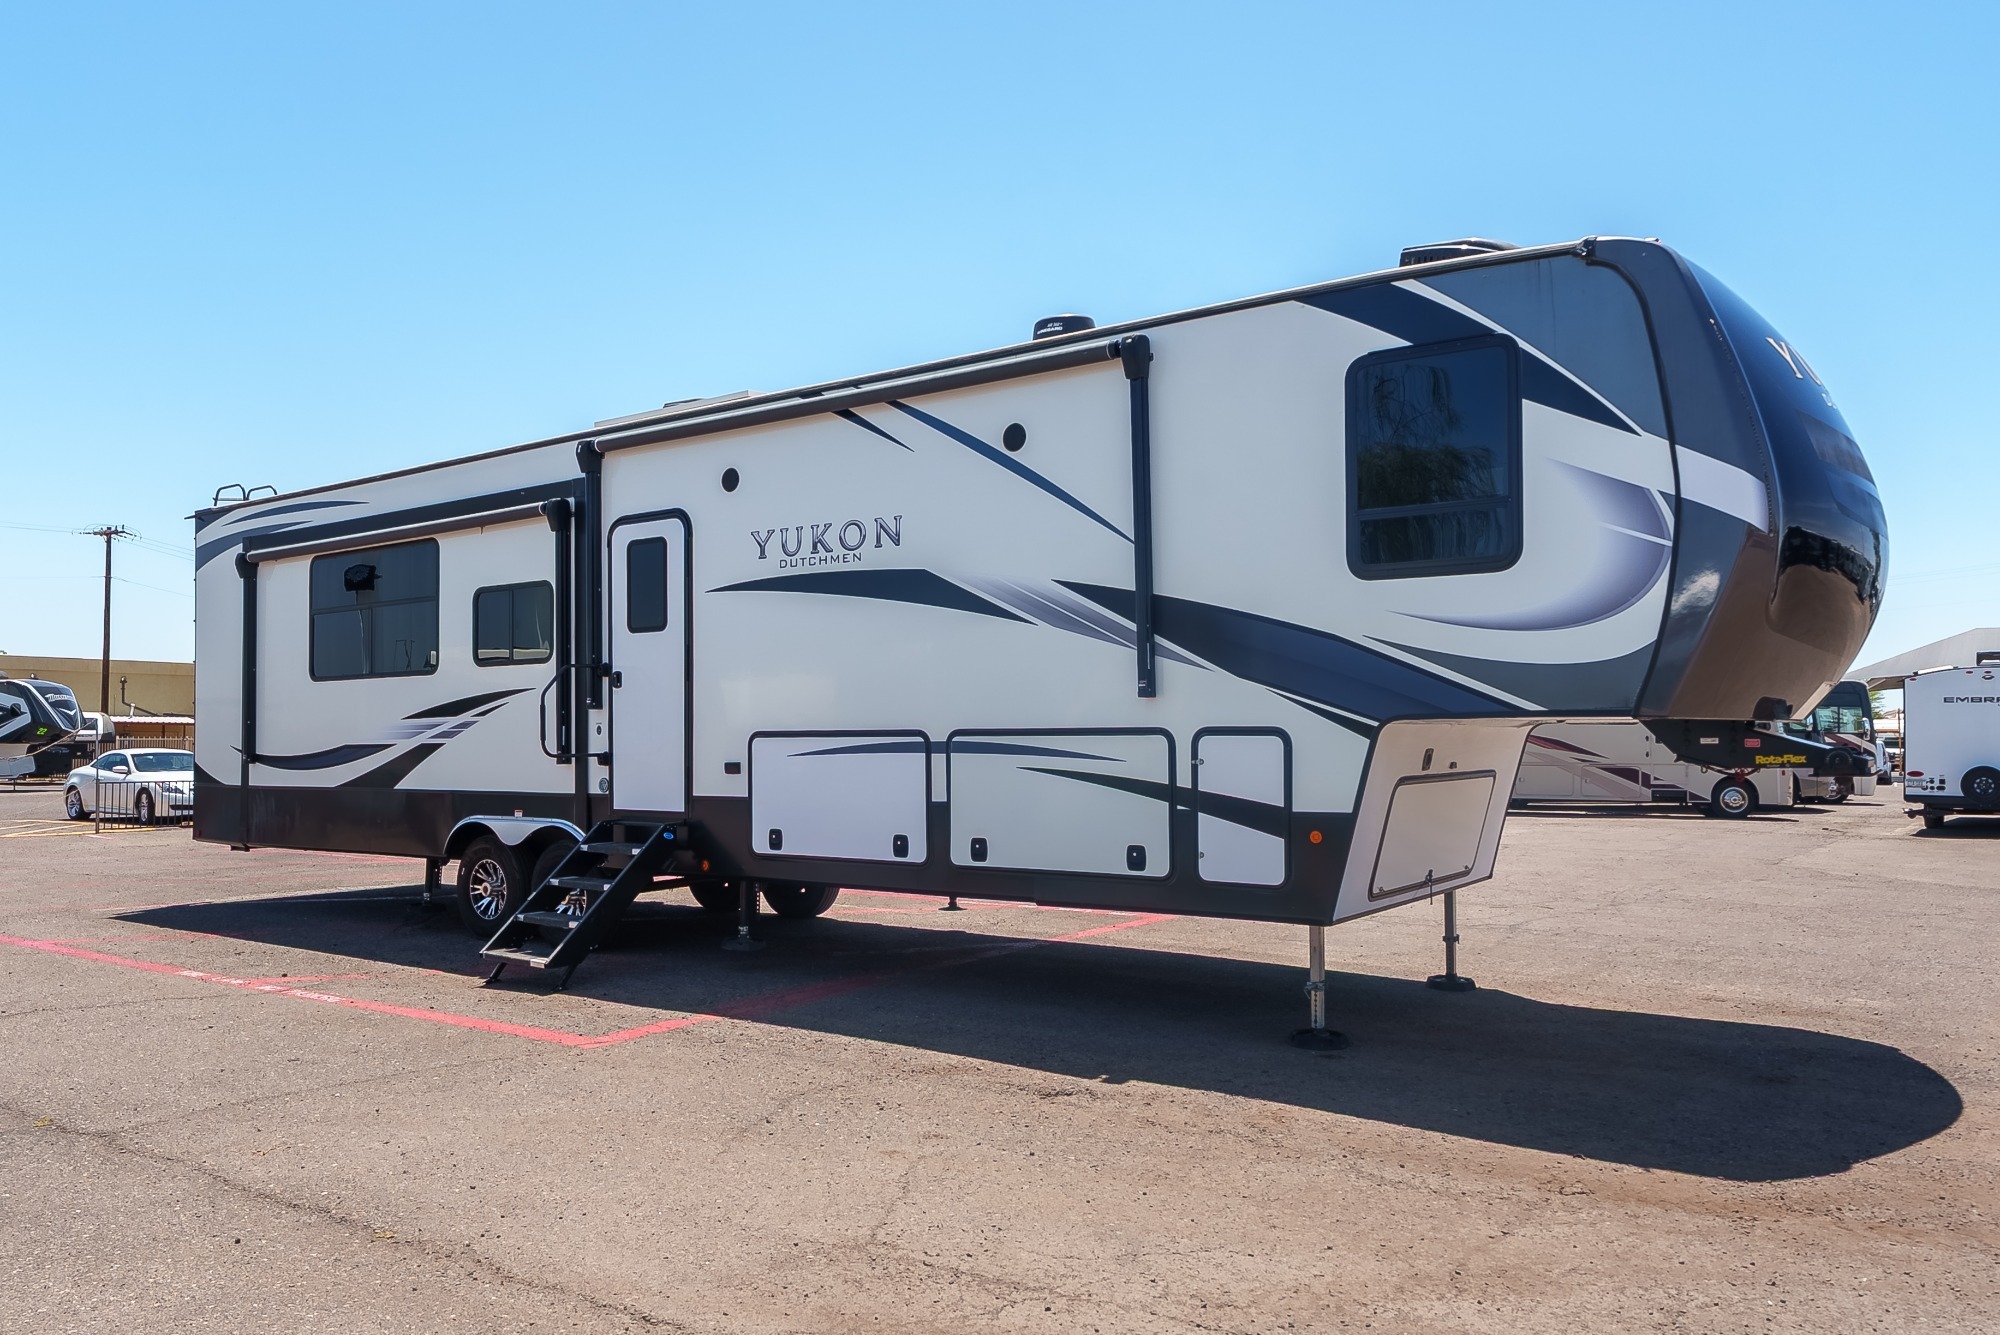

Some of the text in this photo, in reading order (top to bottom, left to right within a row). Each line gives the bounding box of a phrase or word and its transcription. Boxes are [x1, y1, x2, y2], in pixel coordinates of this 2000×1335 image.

[750, 515, 903, 560] YUKON
[779, 552, 862, 569] DUTCHMEN
[36, 727, 48, 735] 22
[1755, 754, 1807, 765] Rota-Flex
